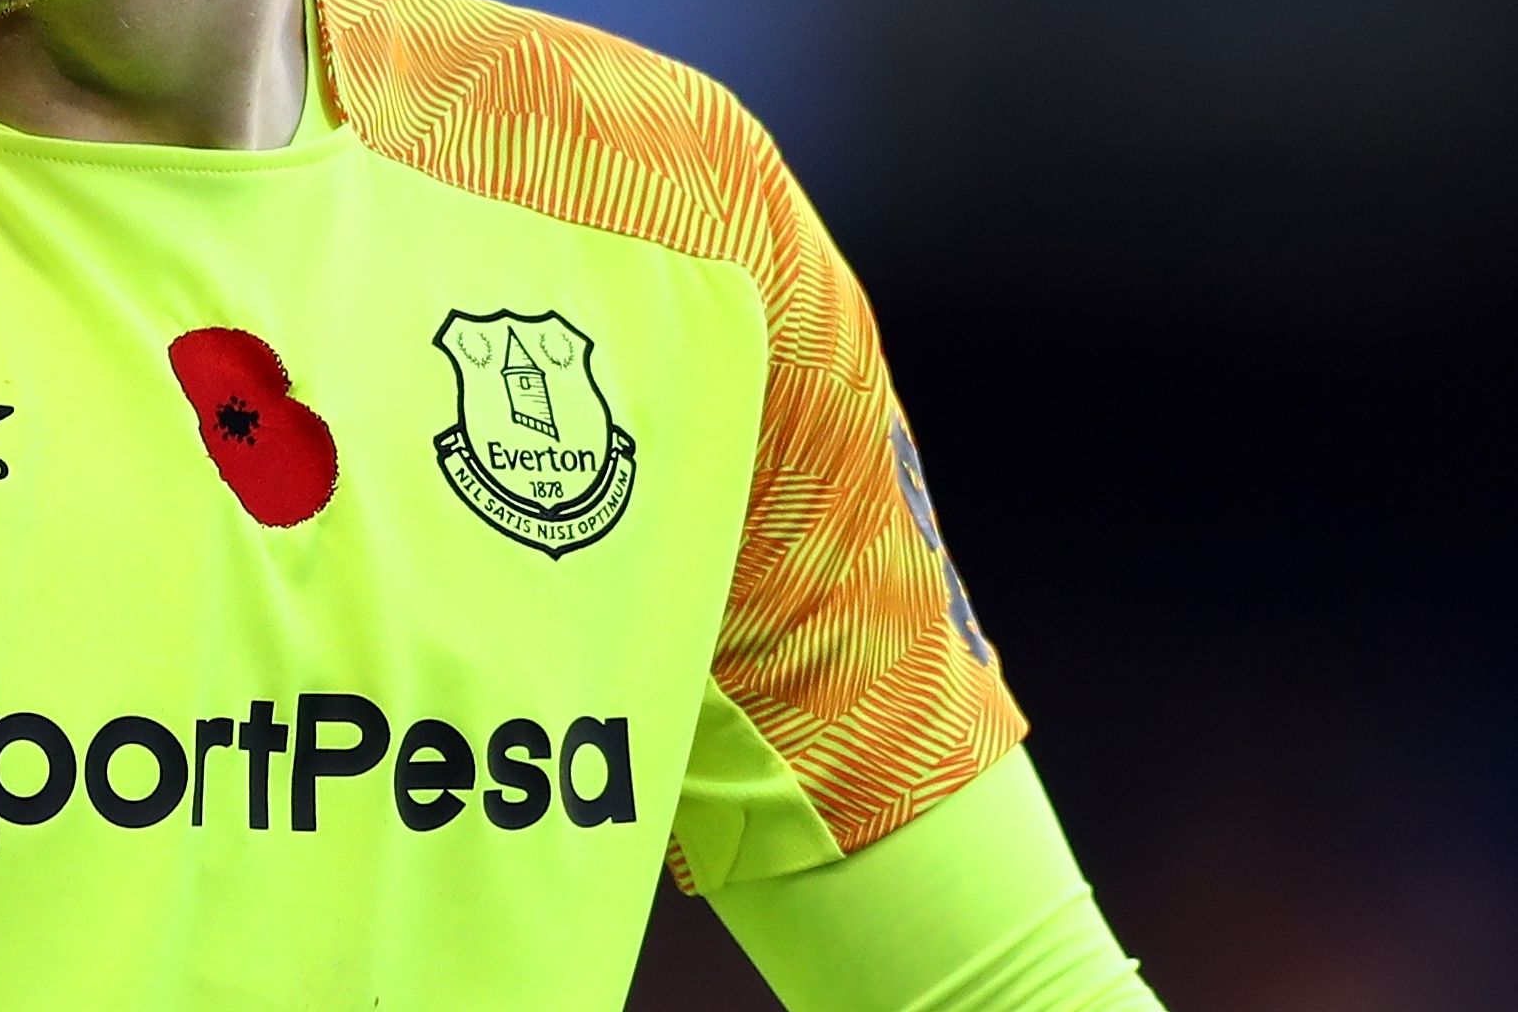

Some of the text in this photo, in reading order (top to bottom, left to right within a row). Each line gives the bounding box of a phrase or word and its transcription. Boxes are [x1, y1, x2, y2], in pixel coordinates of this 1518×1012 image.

[487, 441, 597, 472] Everton
[454, 467, 629, 540] NIL SATIS NISI OPTIMUM
[529, 481, 564, 499] 1878
